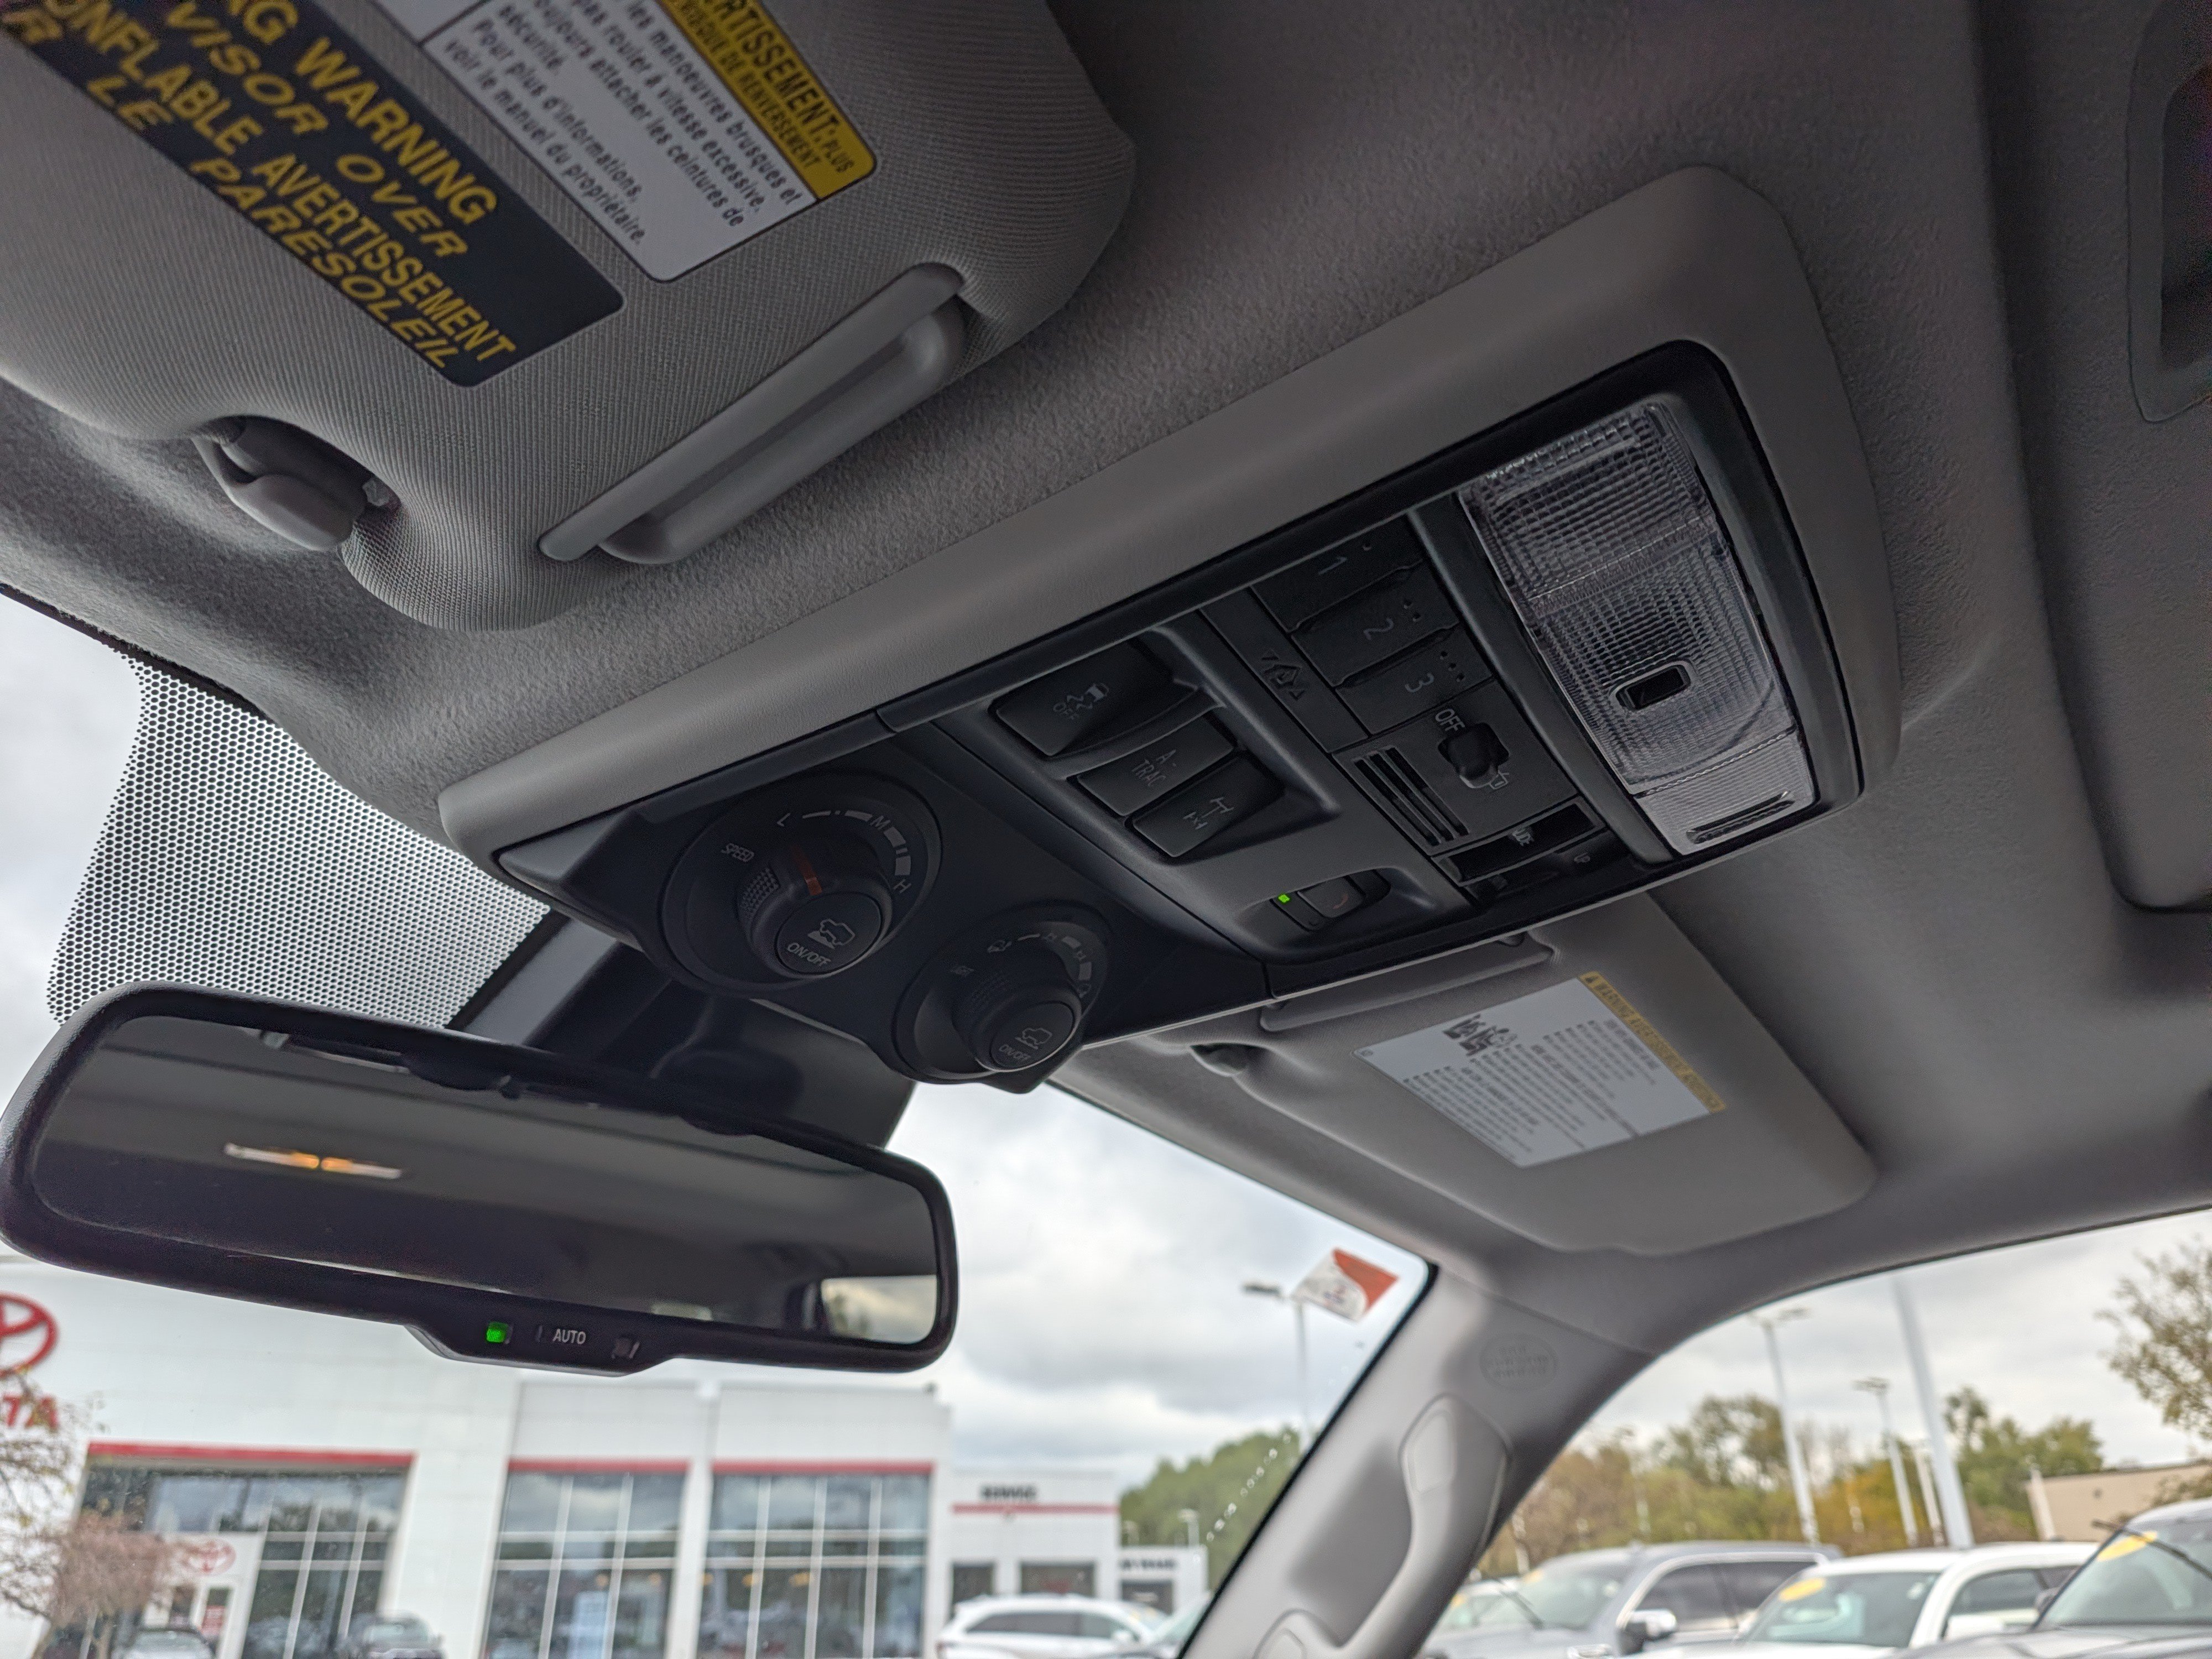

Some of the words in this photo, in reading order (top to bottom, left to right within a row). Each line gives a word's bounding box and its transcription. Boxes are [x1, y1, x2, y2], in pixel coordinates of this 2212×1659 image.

[473, 19, 515, 60] Pour
[504, 61, 547, 98] plus
[602, 25, 653, 72] rouler
[657, 87, 708, 140] vitesse
[445, 39, 482, 71] voir
[477, 67, 497, 90] le
[495, 88, 555, 145] manuel
[546, 143, 571, 165] du
[650, 30, 734, 123] manoeuvres
[725, 120, 785, 189] brusques
[780, 187, 804, 206] et
[168, 2, 329, 135] VISOR
[336, 153, 468, 257] OVER
[295, 36, 497, 225] WARNING
[739, 71, 822, 168] RENVERSEMENT
[588, 58, 650, 121] attacher
[646, 117, 672, 145] les
[667, 144, 728, 208] ceintures
[722, 206, 744, 227] de
[822, 138, 855, 174] PLUS
[87, 75, 174, 131] LE
[189, 156, 458, 369] PARESOLEIL
[251, 153, 517, 362] AVERTISSEMENT
[1318, 556, 1348, 576] 1
[1363, 617, 1395, 640] 2
[1404, 673, 1434, 693] 3
[1435, 707, 1466, 733] OFF
[1131, 758, 1167, 787] TRAC
[776, 812, 792, 828] L
[869, 815, 891, 831] M
[721, 842, 755, 863] SPEED
[893, 879, 912, 895] H
[787, 942, 831, 967] ON/OFF
[552, 1328, 587, 1345] AUTO
